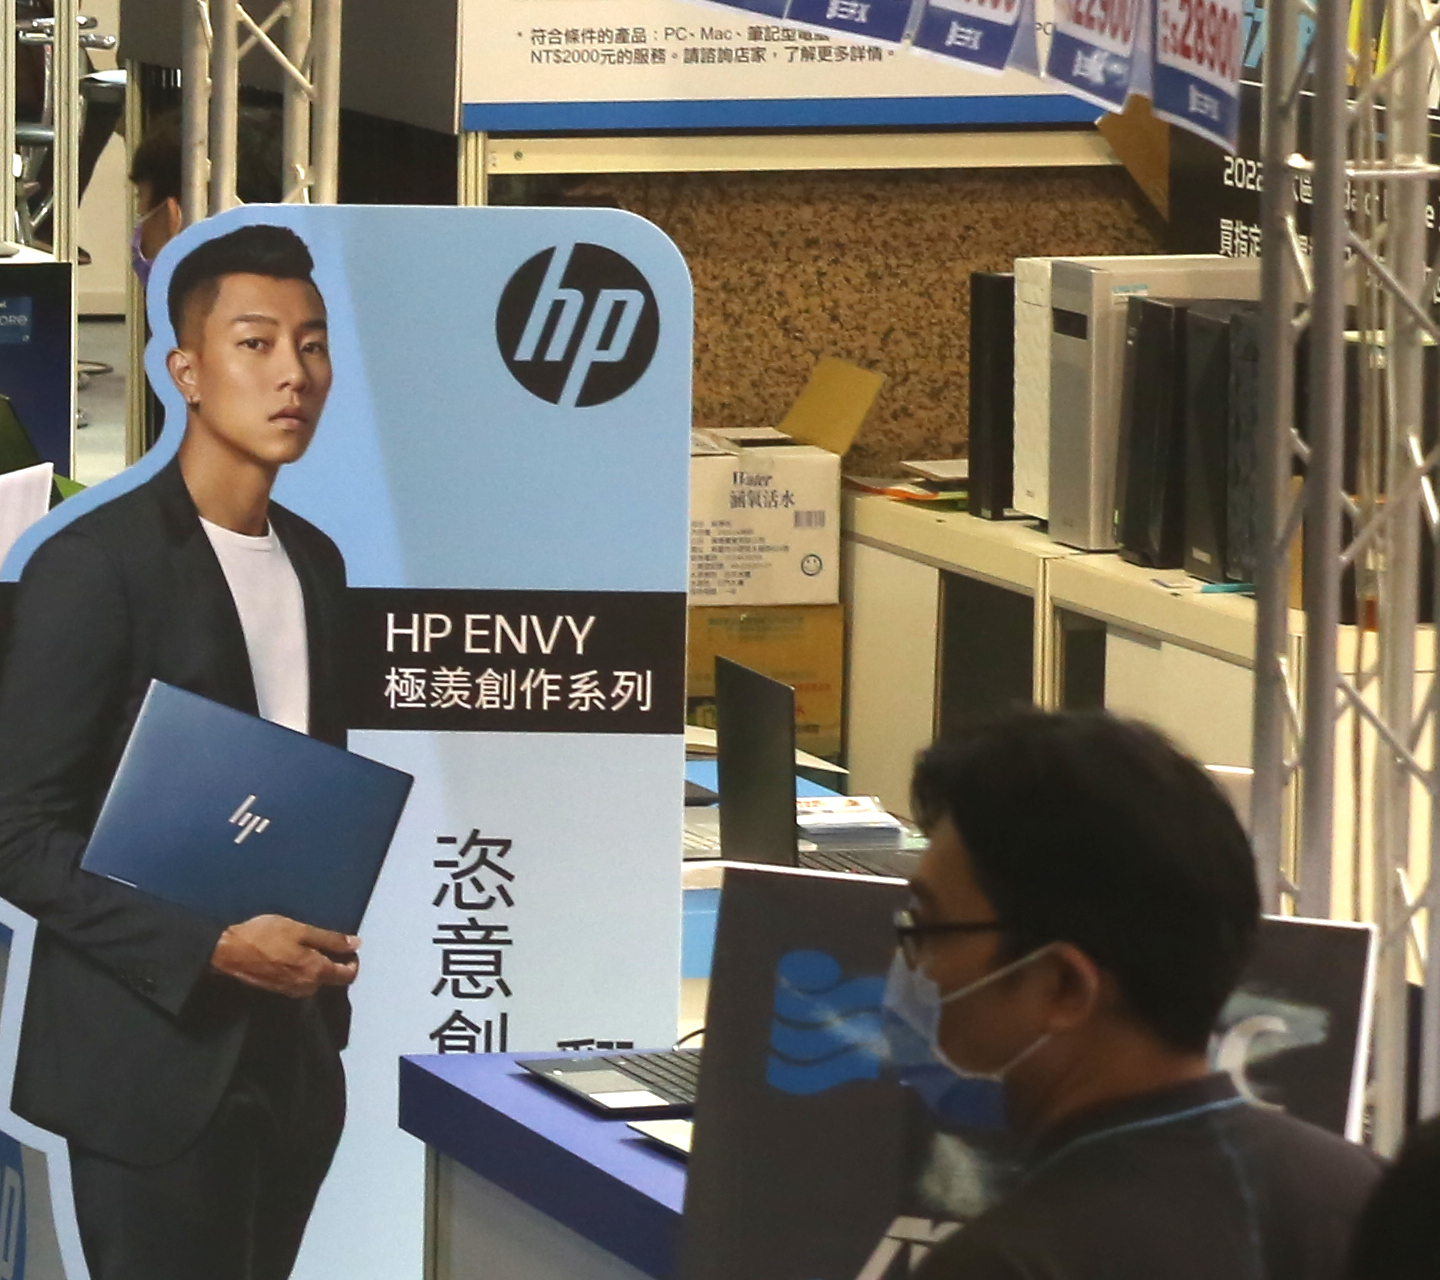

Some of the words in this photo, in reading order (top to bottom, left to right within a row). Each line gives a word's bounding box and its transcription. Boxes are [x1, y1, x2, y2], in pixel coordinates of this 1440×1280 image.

[512, 242, 646, 408] hp
[386, 616, 452, 654] HP
[463, 614, 595, 654] ENVY
[384, 667, 653, 712] 極羨創作系列
